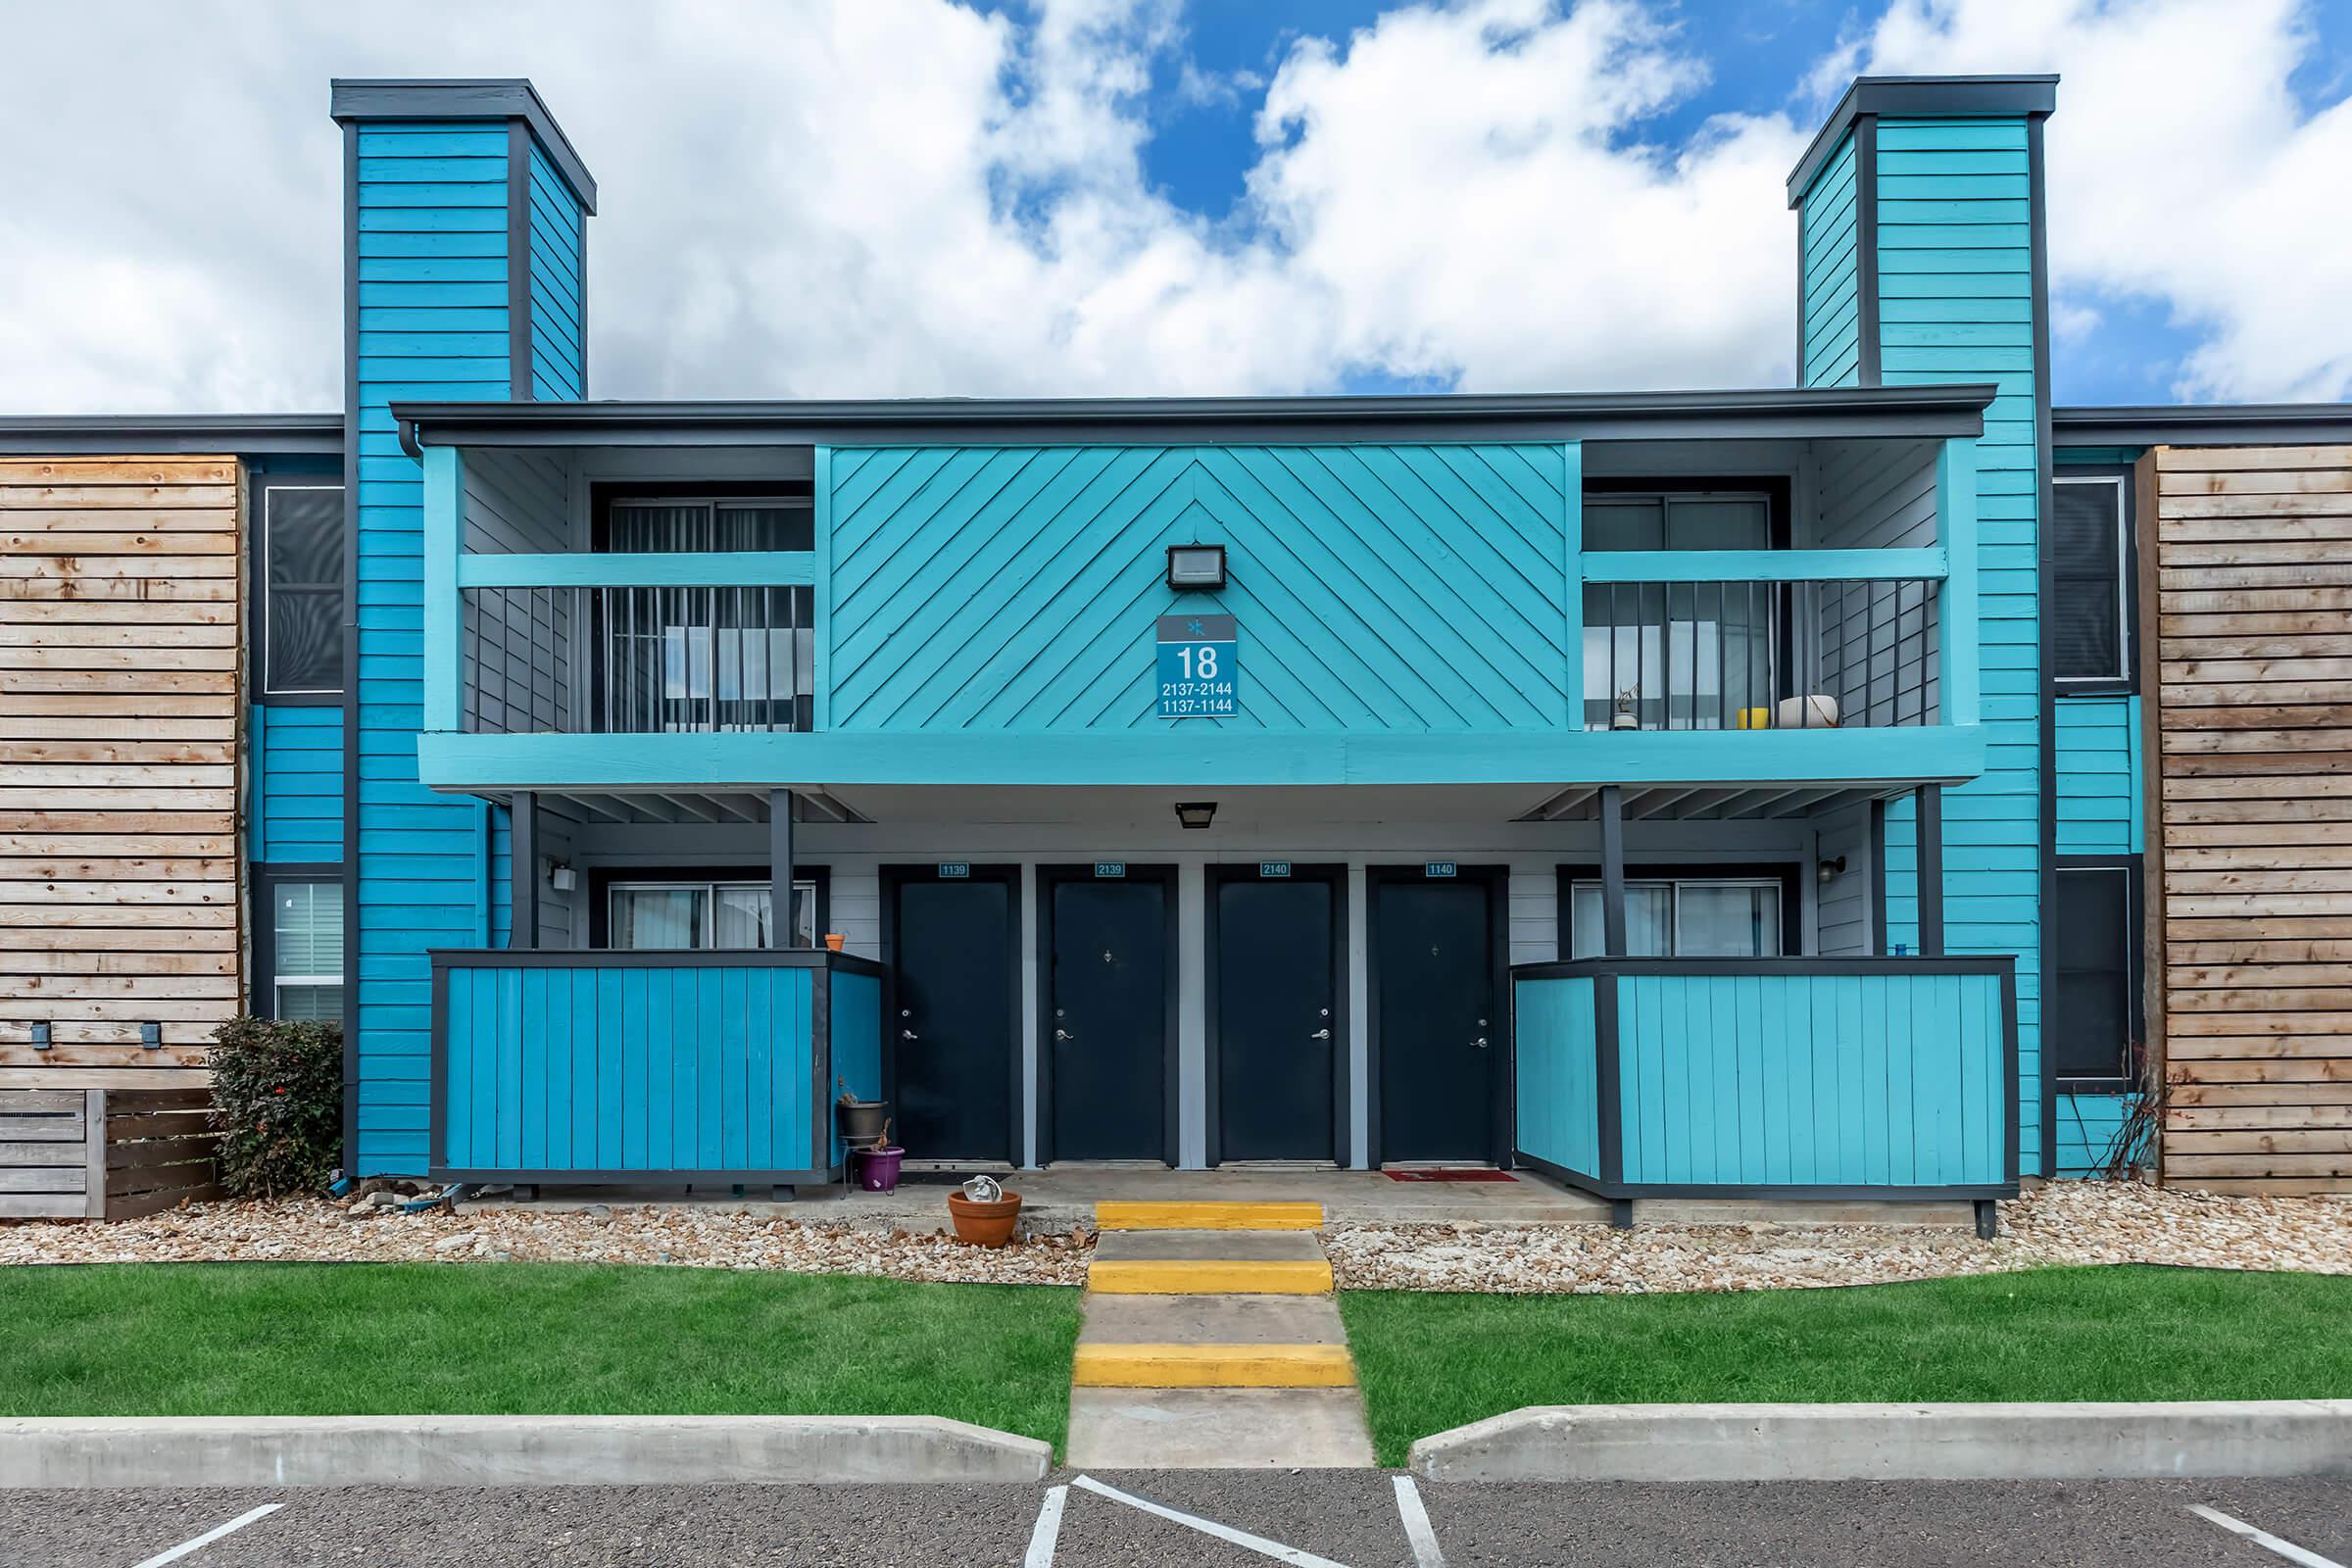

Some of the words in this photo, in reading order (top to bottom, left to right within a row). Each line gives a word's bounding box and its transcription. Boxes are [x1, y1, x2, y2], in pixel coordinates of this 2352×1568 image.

[1177, 647, 1218, 679] 18
[1162, 682, 1233, 697] 2137-2144
[1163, 699, 1233, 713] 1137-1144
[943, 865, 965, 875] 1139
[1099, 864, 1122, 875] 2139
[1263, 864, 1287, 874] 2140
[1430, 863, 1452, 874] 1140
